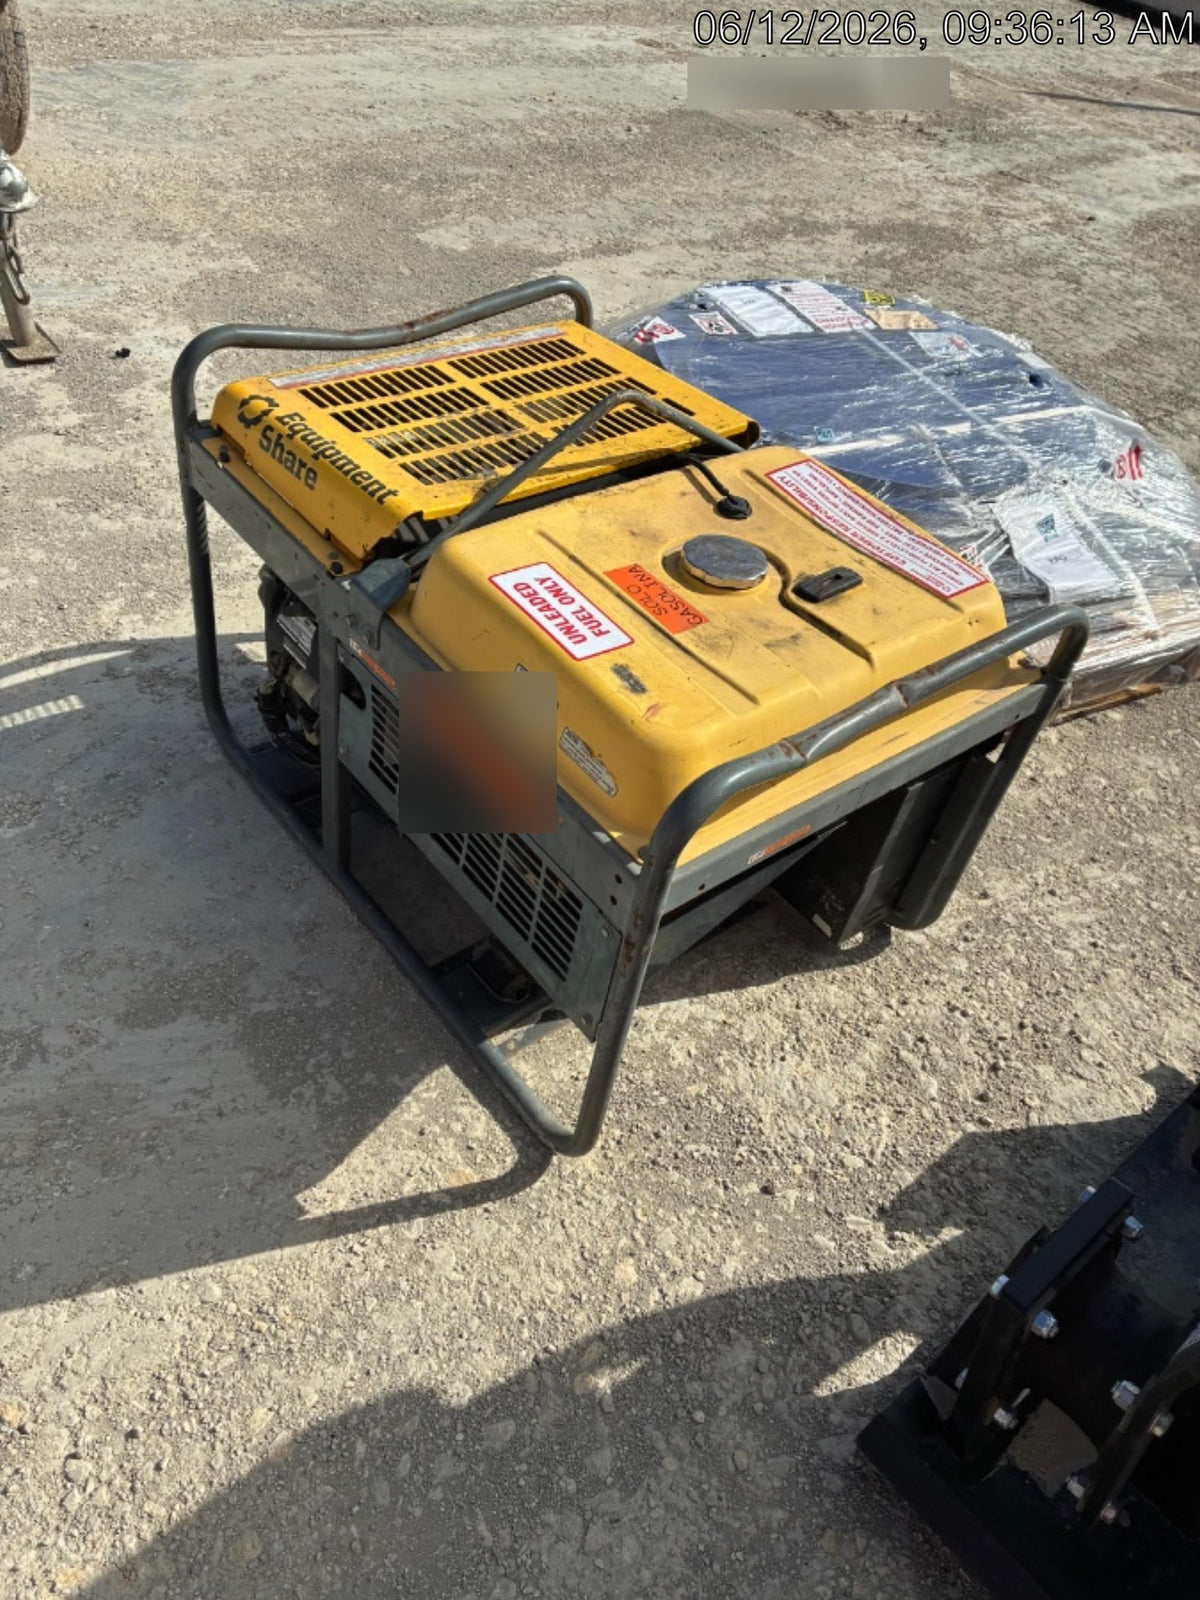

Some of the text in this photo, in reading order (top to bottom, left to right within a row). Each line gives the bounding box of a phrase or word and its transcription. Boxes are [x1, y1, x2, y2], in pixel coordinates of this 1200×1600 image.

[259, 424, 318, 491] Share
[275, 412, 398, 505] Equipment
[777, 475, 852, 532] RESPONSIBILITY
[513, 581, 588, 645] UNLEADED
[533, 576, 611, 637] FUEL ONLY
[626, 583, 668, 617] SOLO
[627, 562, 703, 626] GASOLINA
